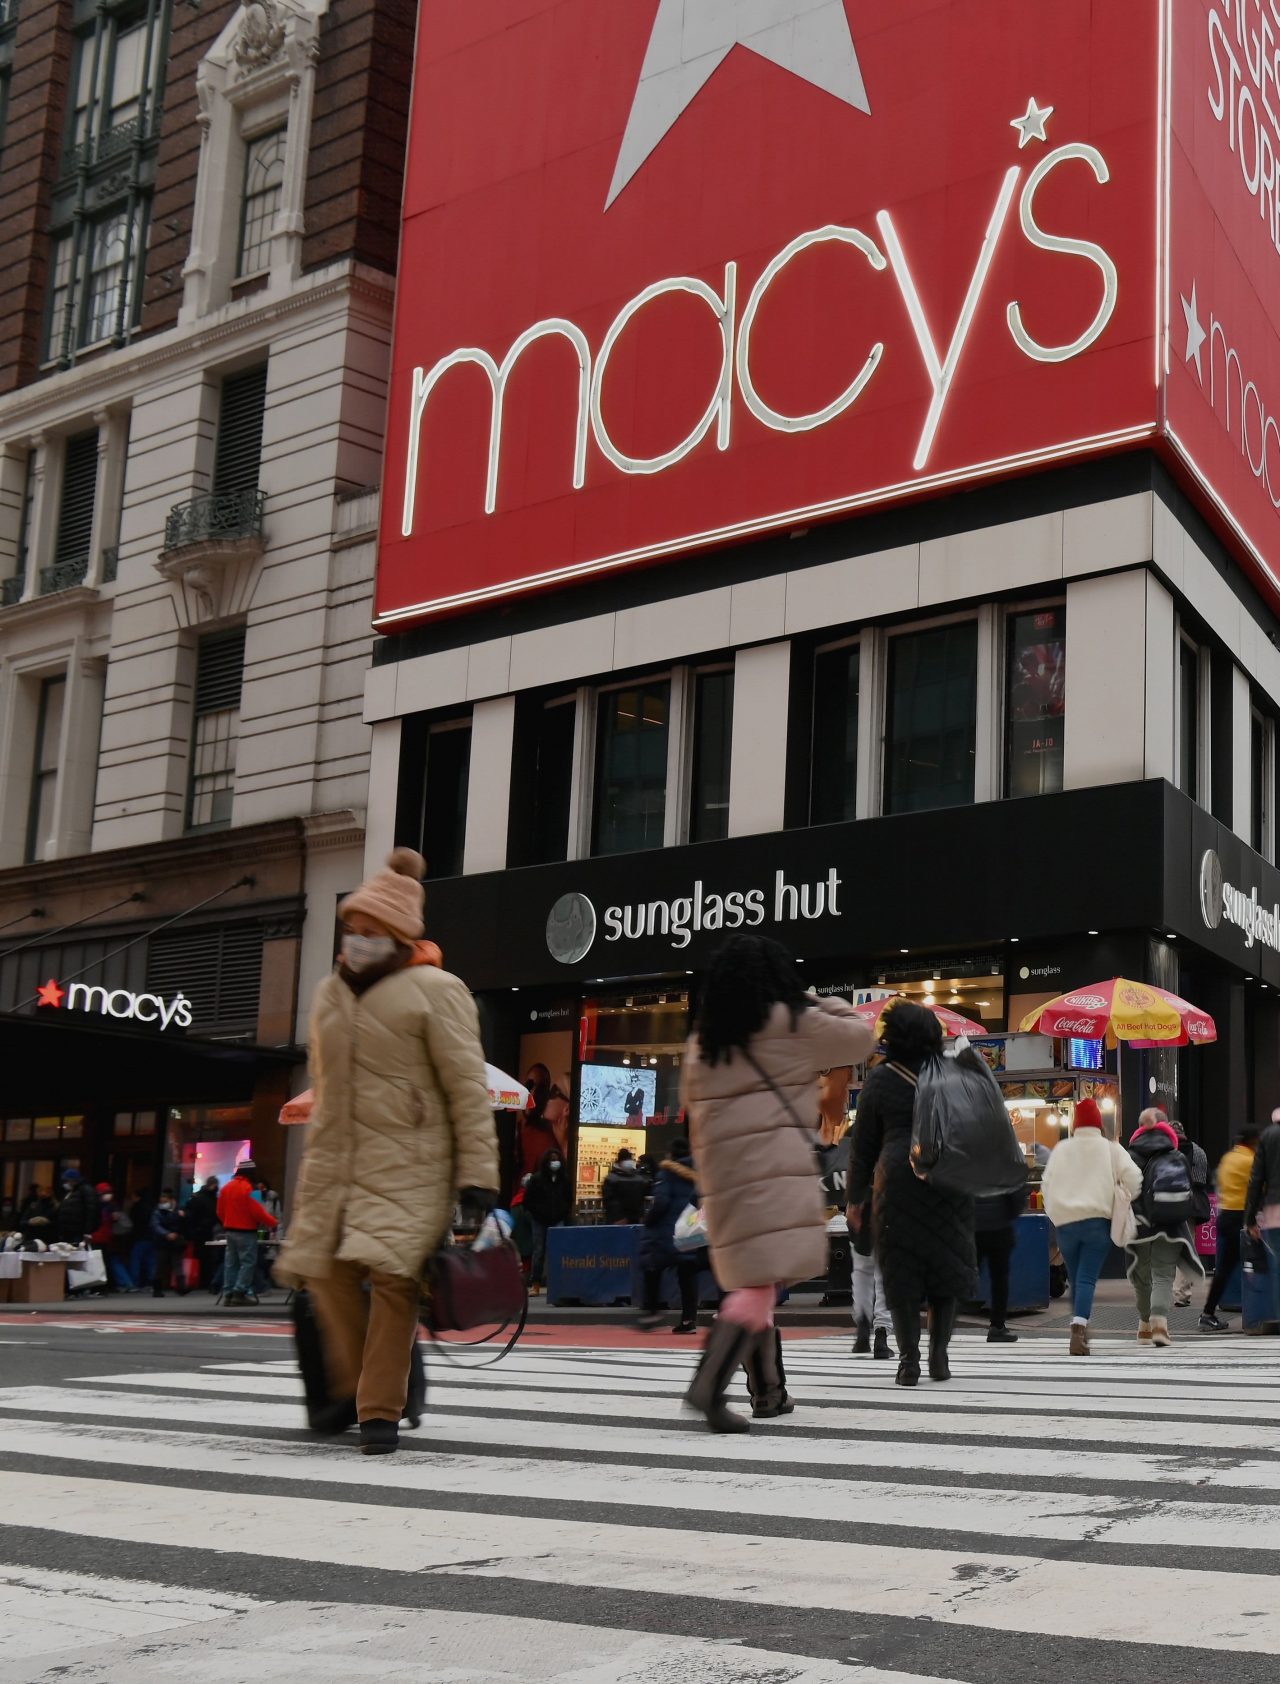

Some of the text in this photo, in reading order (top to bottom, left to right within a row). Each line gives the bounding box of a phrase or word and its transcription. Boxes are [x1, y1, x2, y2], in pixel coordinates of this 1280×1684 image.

[604, 868, 842, 948] sunglass hut
[1030, 966, 1061, 977] sunglass
[817, 984, 843, 996] sunglass
[67, 983, 193, 1032] macy's
[1053, 1017, 1098, 1034] Coca-Cola
[1116, 1022, 1177, 1032] All Beef Hot Dogs
[562, 1255, 630, 1270] Herald Squar
